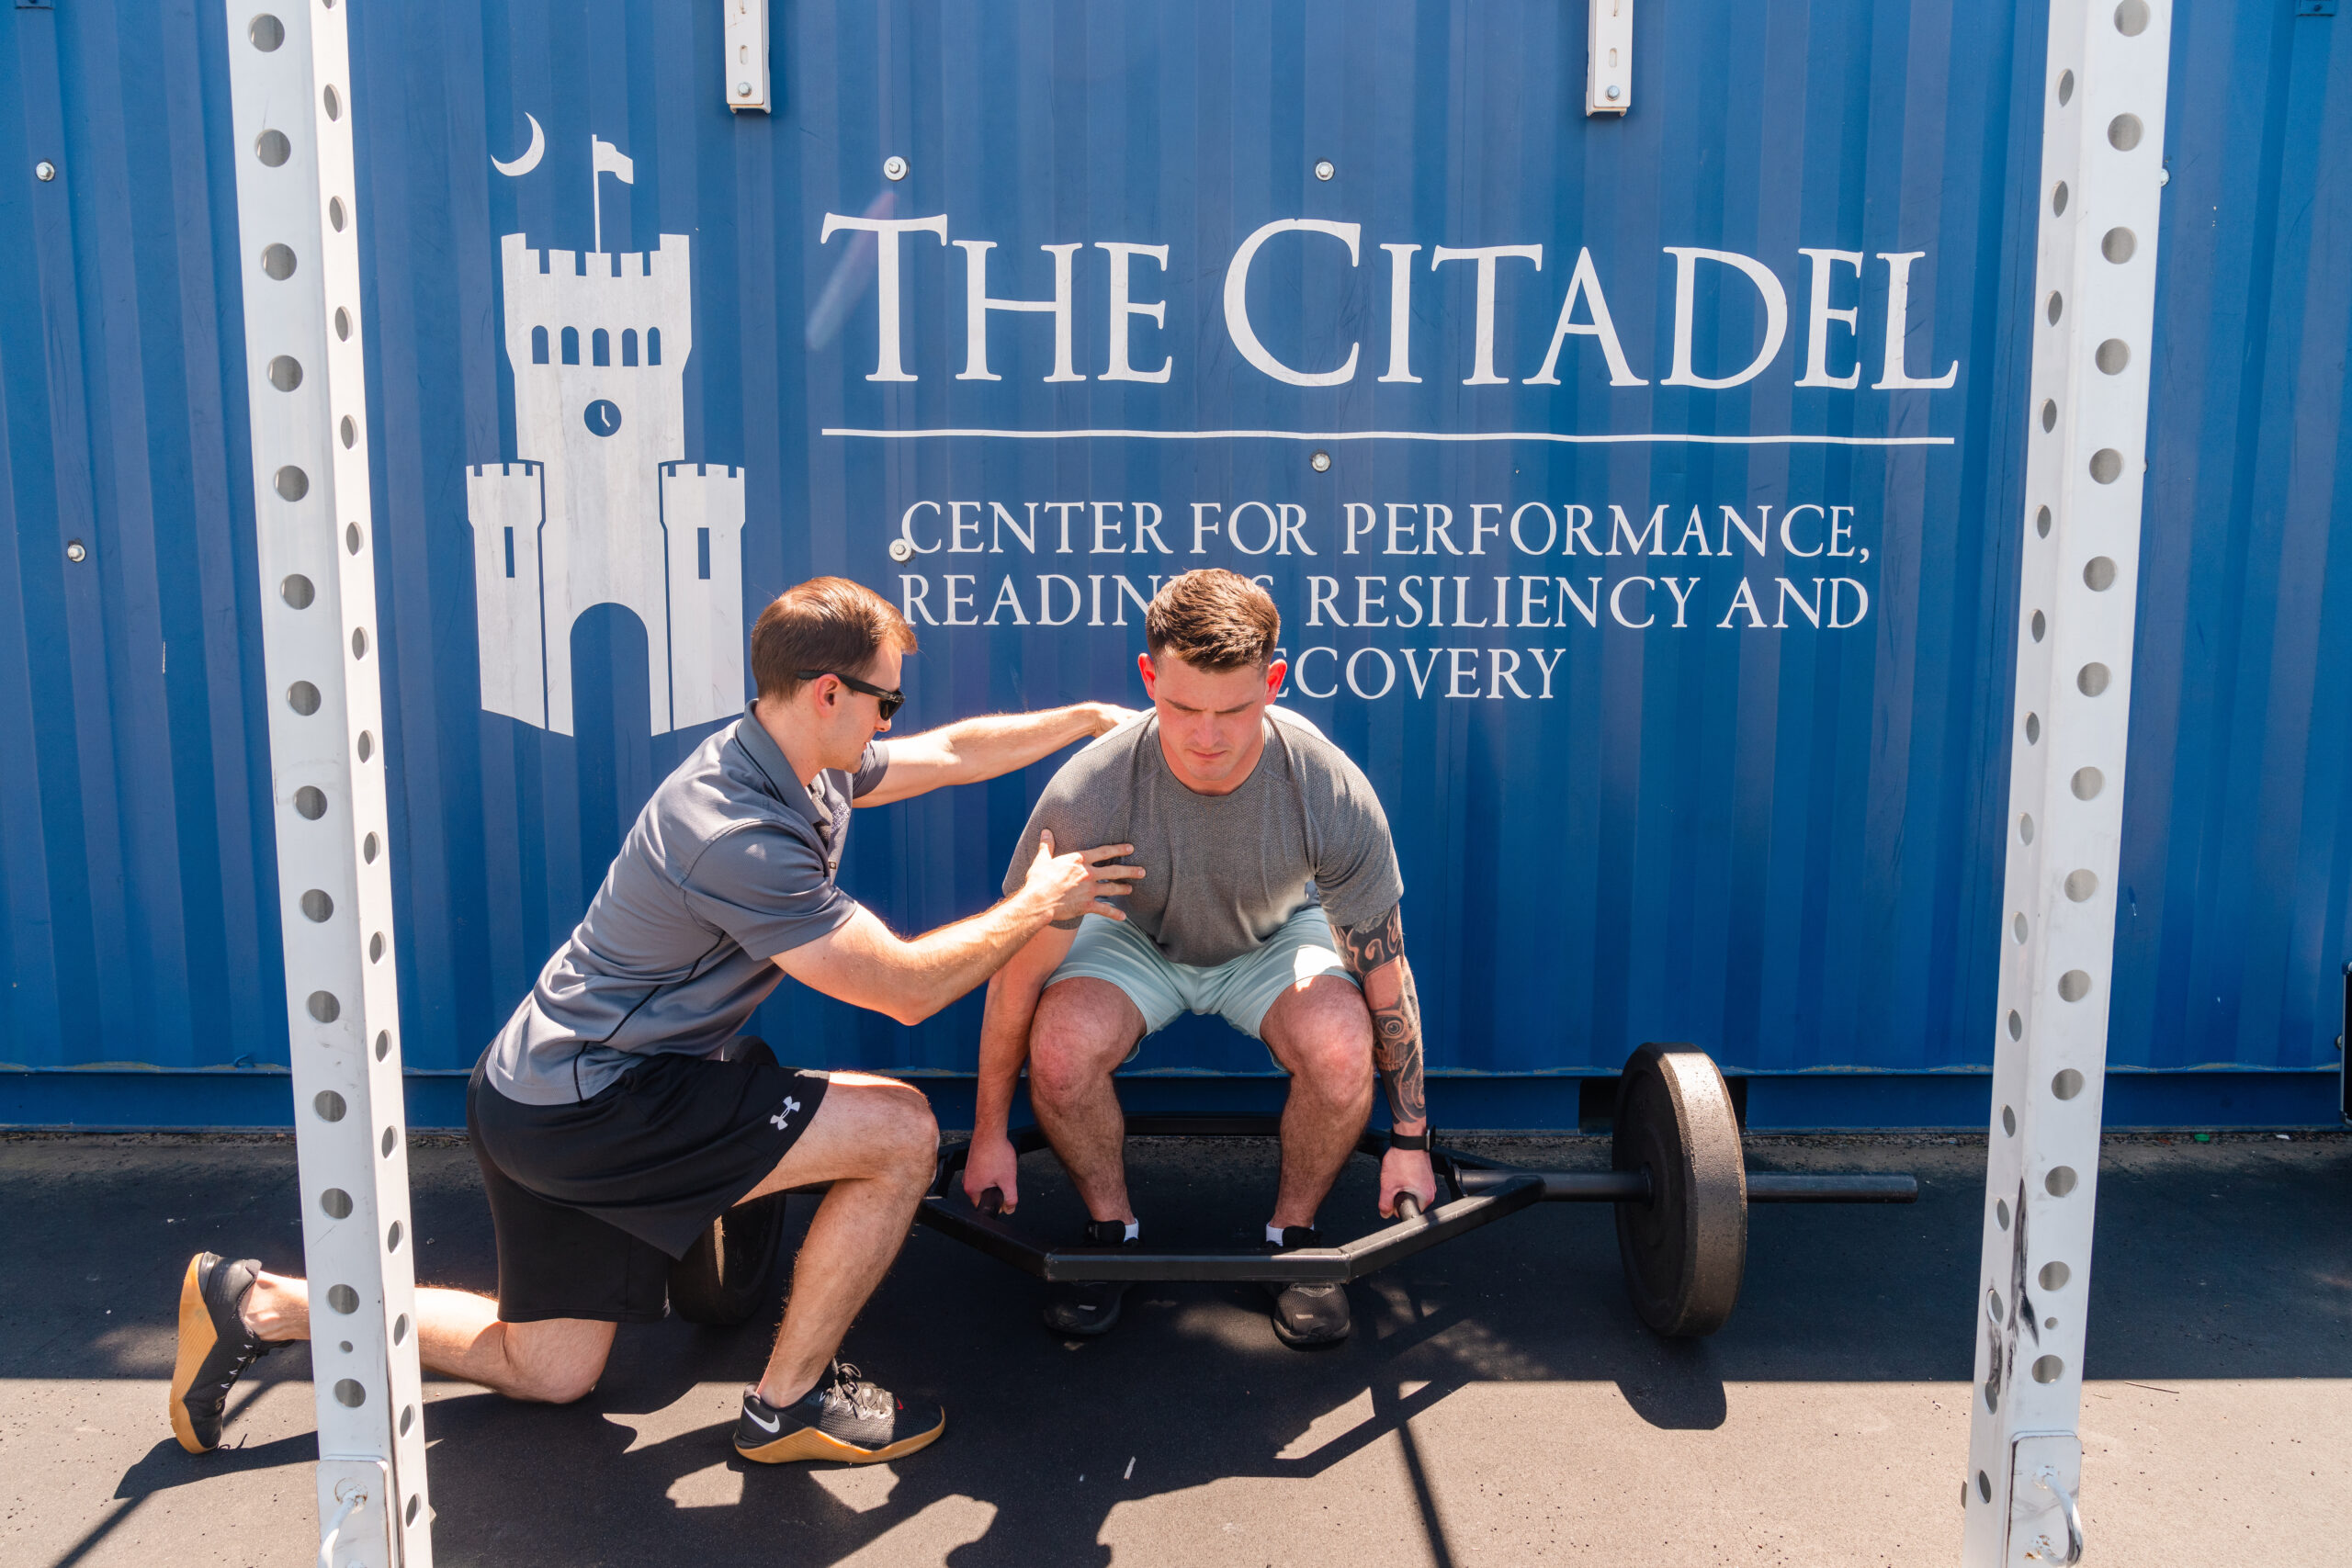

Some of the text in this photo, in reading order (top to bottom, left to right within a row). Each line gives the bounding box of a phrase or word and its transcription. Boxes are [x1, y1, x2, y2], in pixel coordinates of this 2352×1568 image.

[820, 212, 1959, 389] THE CITADEL
[900, 501, 1870, 563] CENTER FOR PERFORMANCE,
[898, 574, 1869, 628] READIN RESILIENCY AND
[1272, 646, 1566, 700] COVERY
